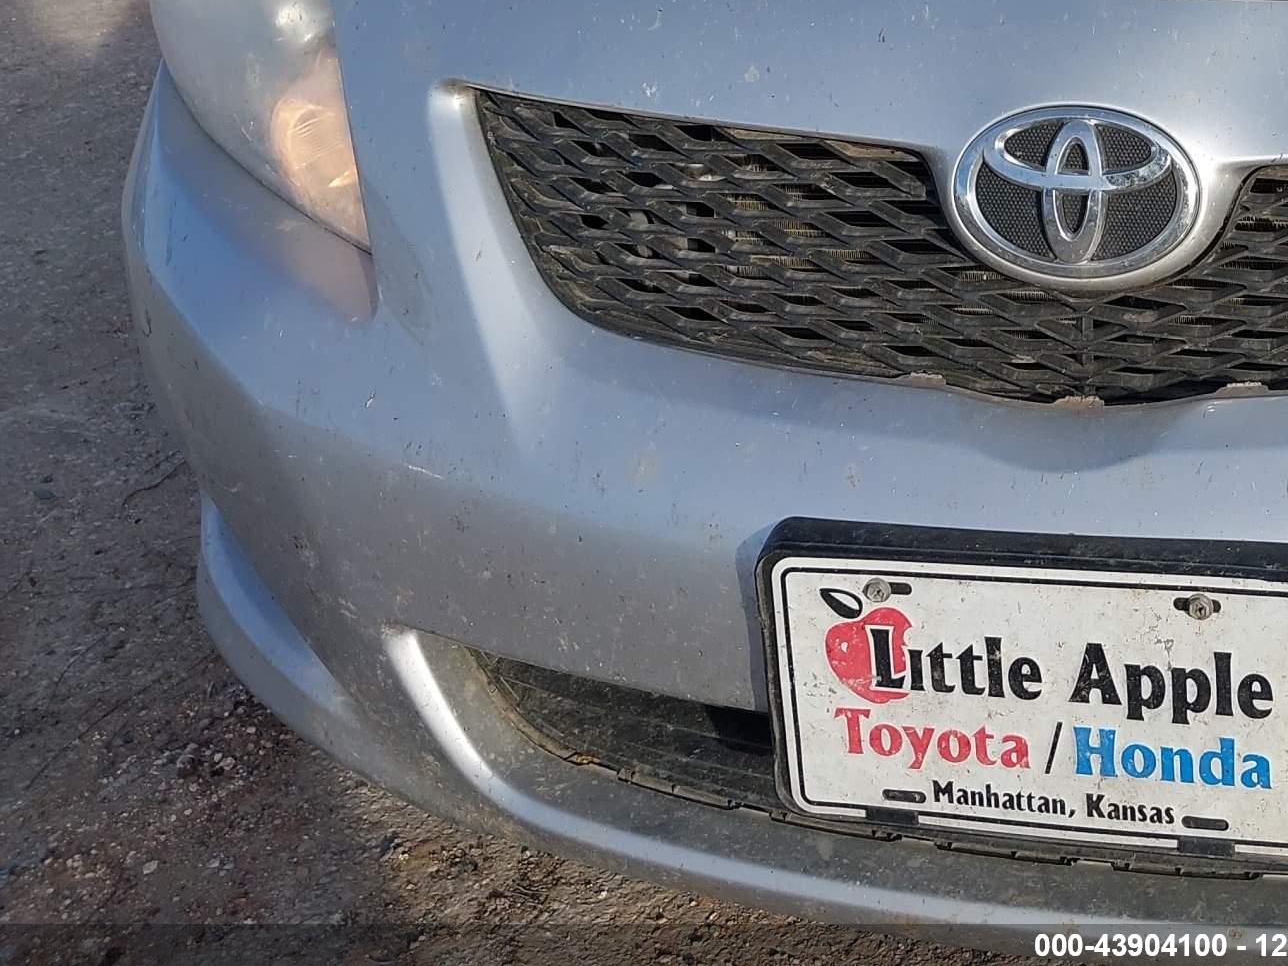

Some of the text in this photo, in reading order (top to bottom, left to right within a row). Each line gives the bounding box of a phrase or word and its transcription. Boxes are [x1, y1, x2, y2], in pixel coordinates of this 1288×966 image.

[866, 626, 1274, 724] Little Apple
[834, 707, 1030, 770] Toyota
[1073, 724, 1272, 790] Honda
[932, 780, 1175, 826] Manhattan, Kansas
